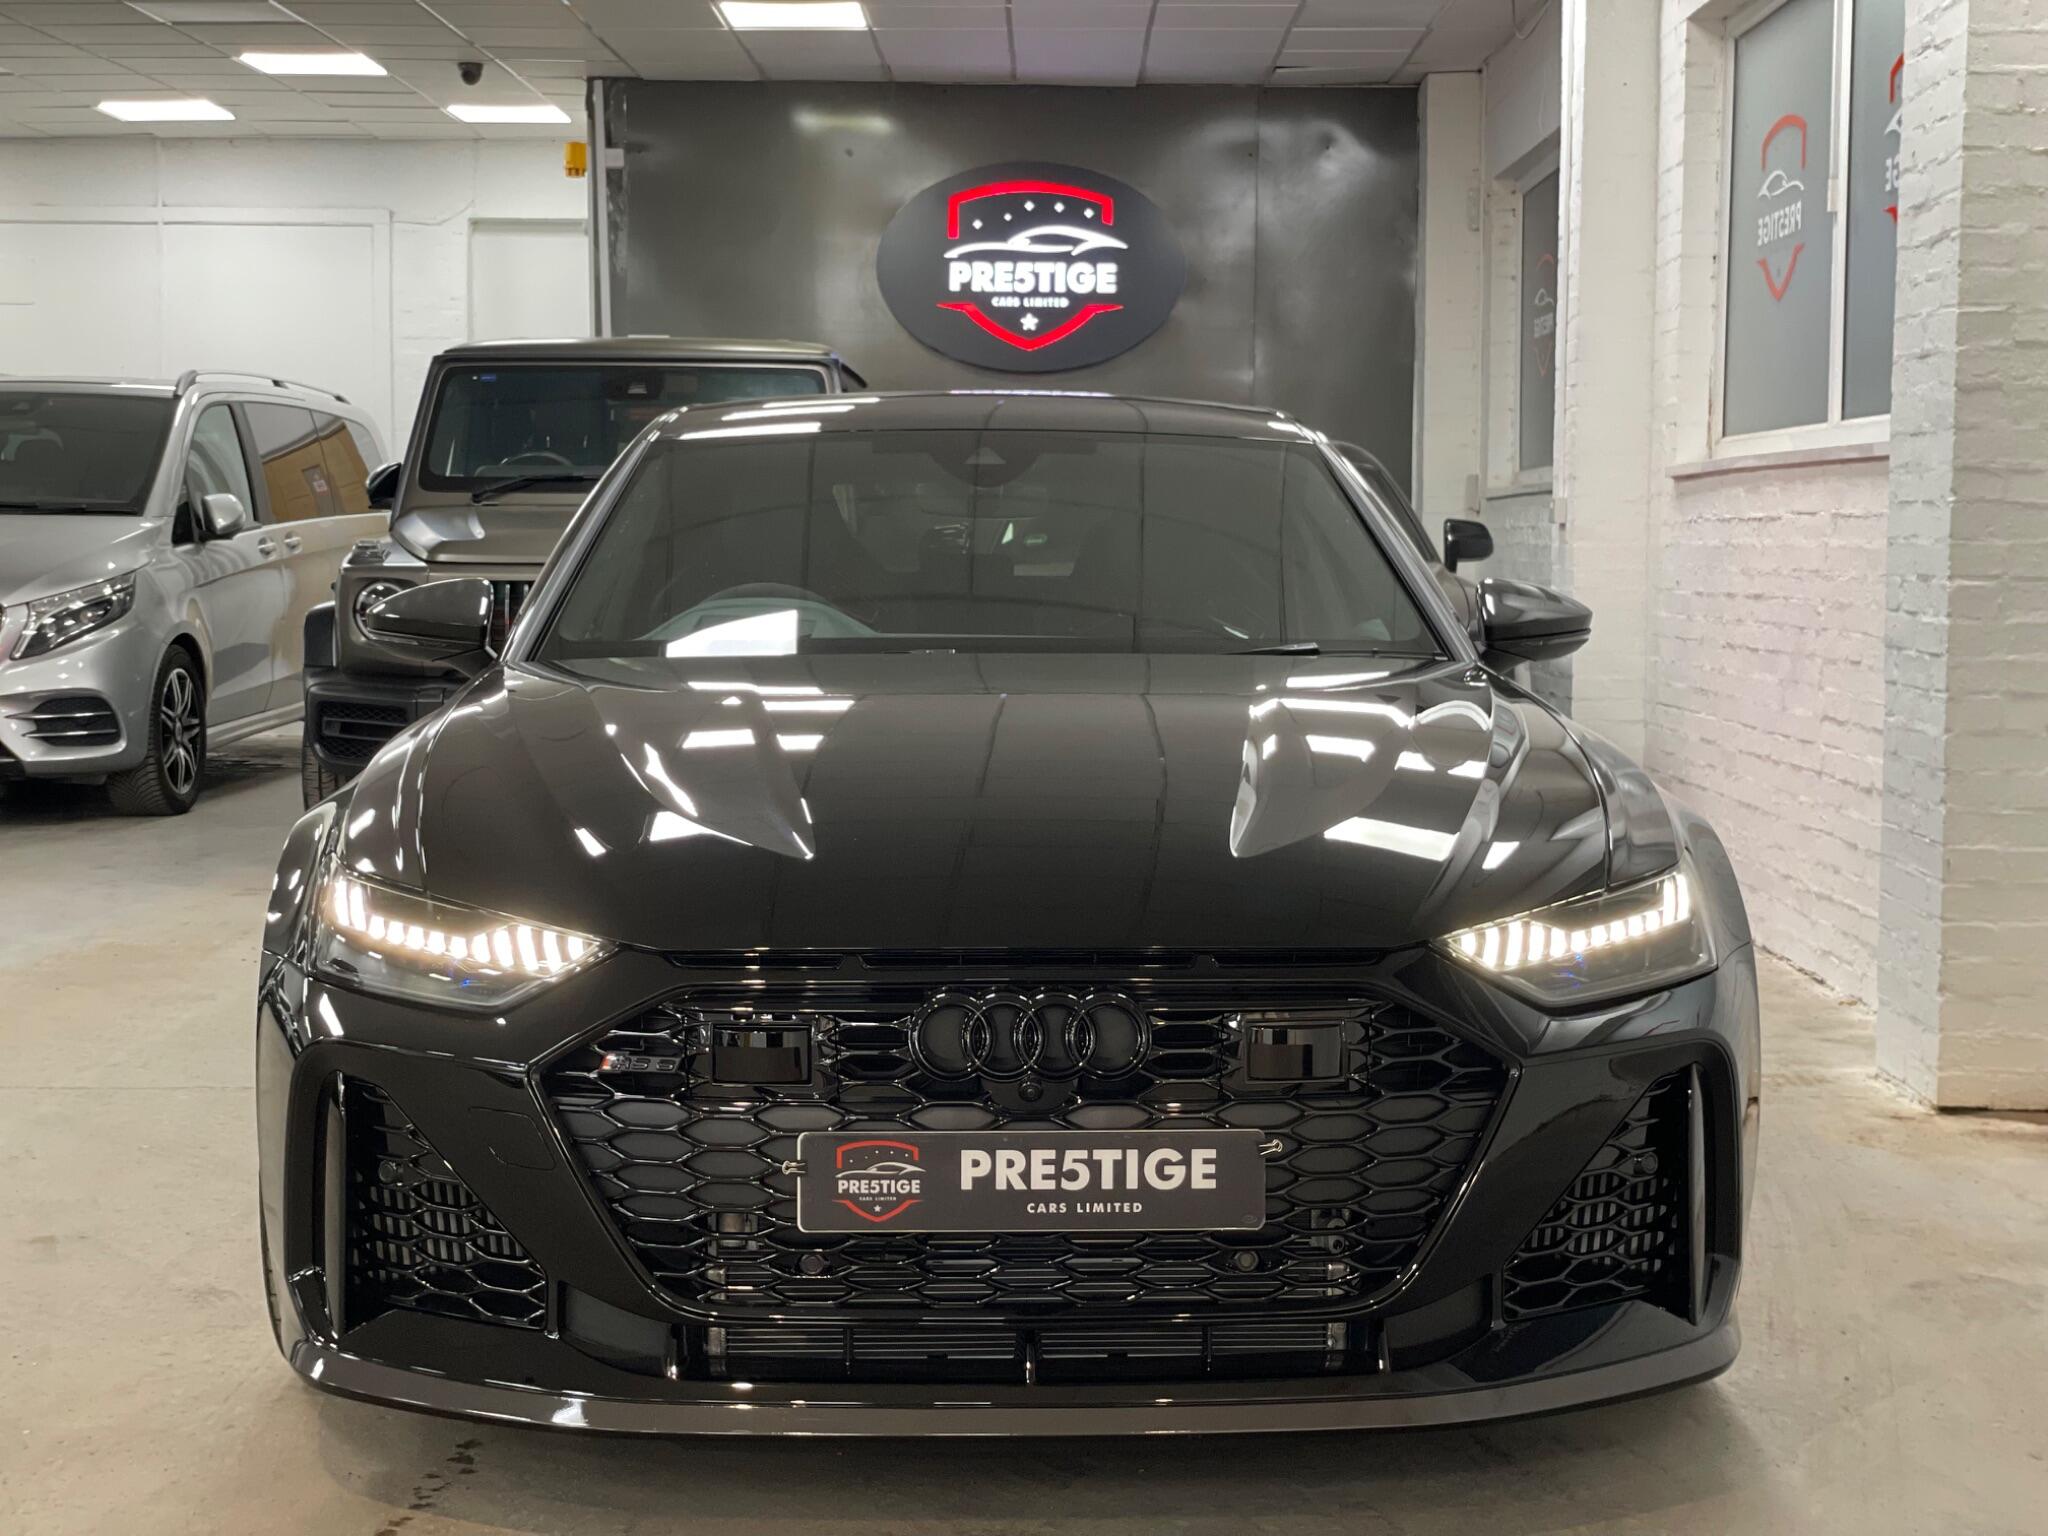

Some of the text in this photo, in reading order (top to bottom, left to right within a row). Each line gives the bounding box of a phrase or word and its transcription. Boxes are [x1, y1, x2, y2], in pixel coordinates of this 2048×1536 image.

[949, 262, 1118, 294] PRE5TIGE
[960, 1148, 1217, 1191] PRE5TIGE
[837, 1179, 921, 1194] PRE5TIGE
[1027, 1202, 1143, 1213] CARS LIMITED
